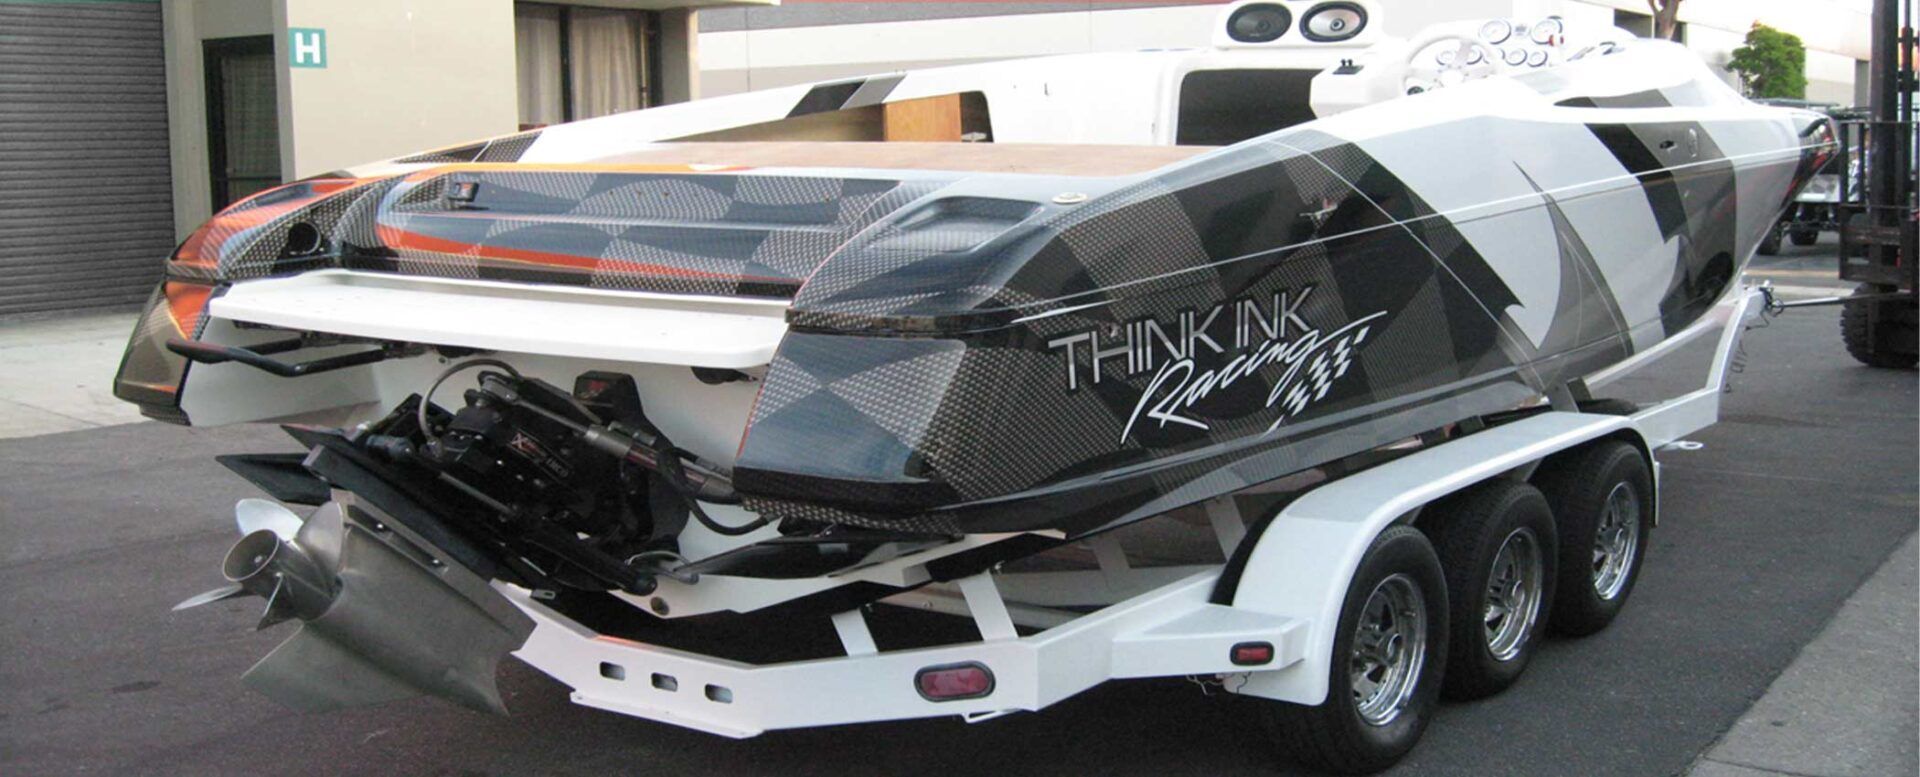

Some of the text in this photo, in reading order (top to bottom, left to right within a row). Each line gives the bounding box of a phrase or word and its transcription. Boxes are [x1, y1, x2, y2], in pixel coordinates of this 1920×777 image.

[294, 32, 320, 64] H
[1048, 286, 1314, 390] THINK INK
[1120, 310, 1388, 445] Racing
